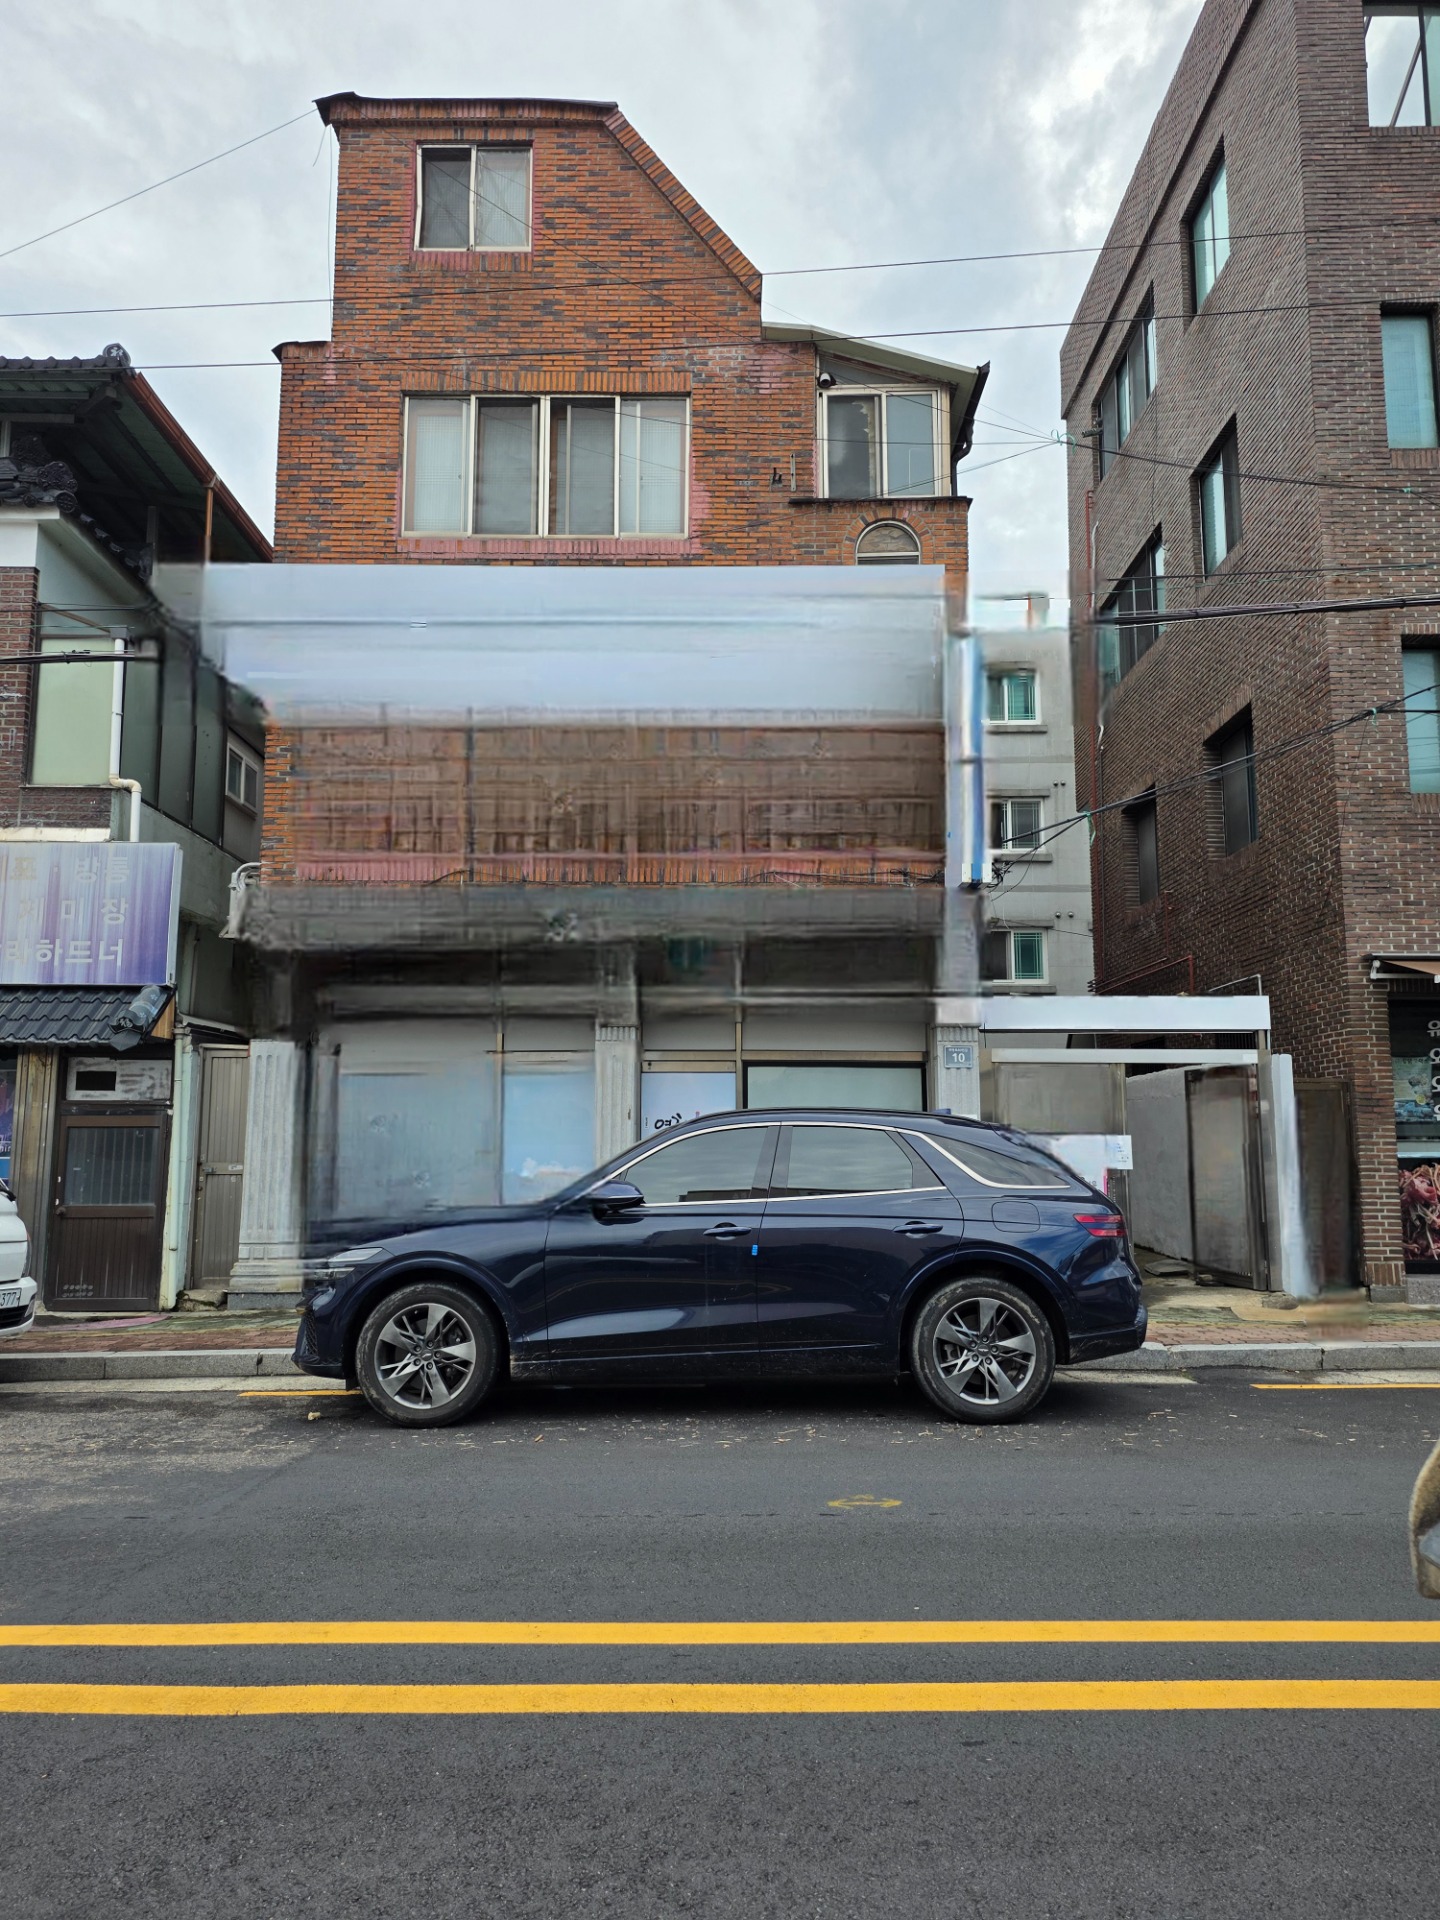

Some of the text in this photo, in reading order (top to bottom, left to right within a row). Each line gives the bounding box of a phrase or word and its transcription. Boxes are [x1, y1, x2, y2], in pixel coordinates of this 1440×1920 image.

[0, 938, 123, 966] 라하드너
[952, 1053, 965, 1063] 10
[0, 1291, 17, 1307] 377
